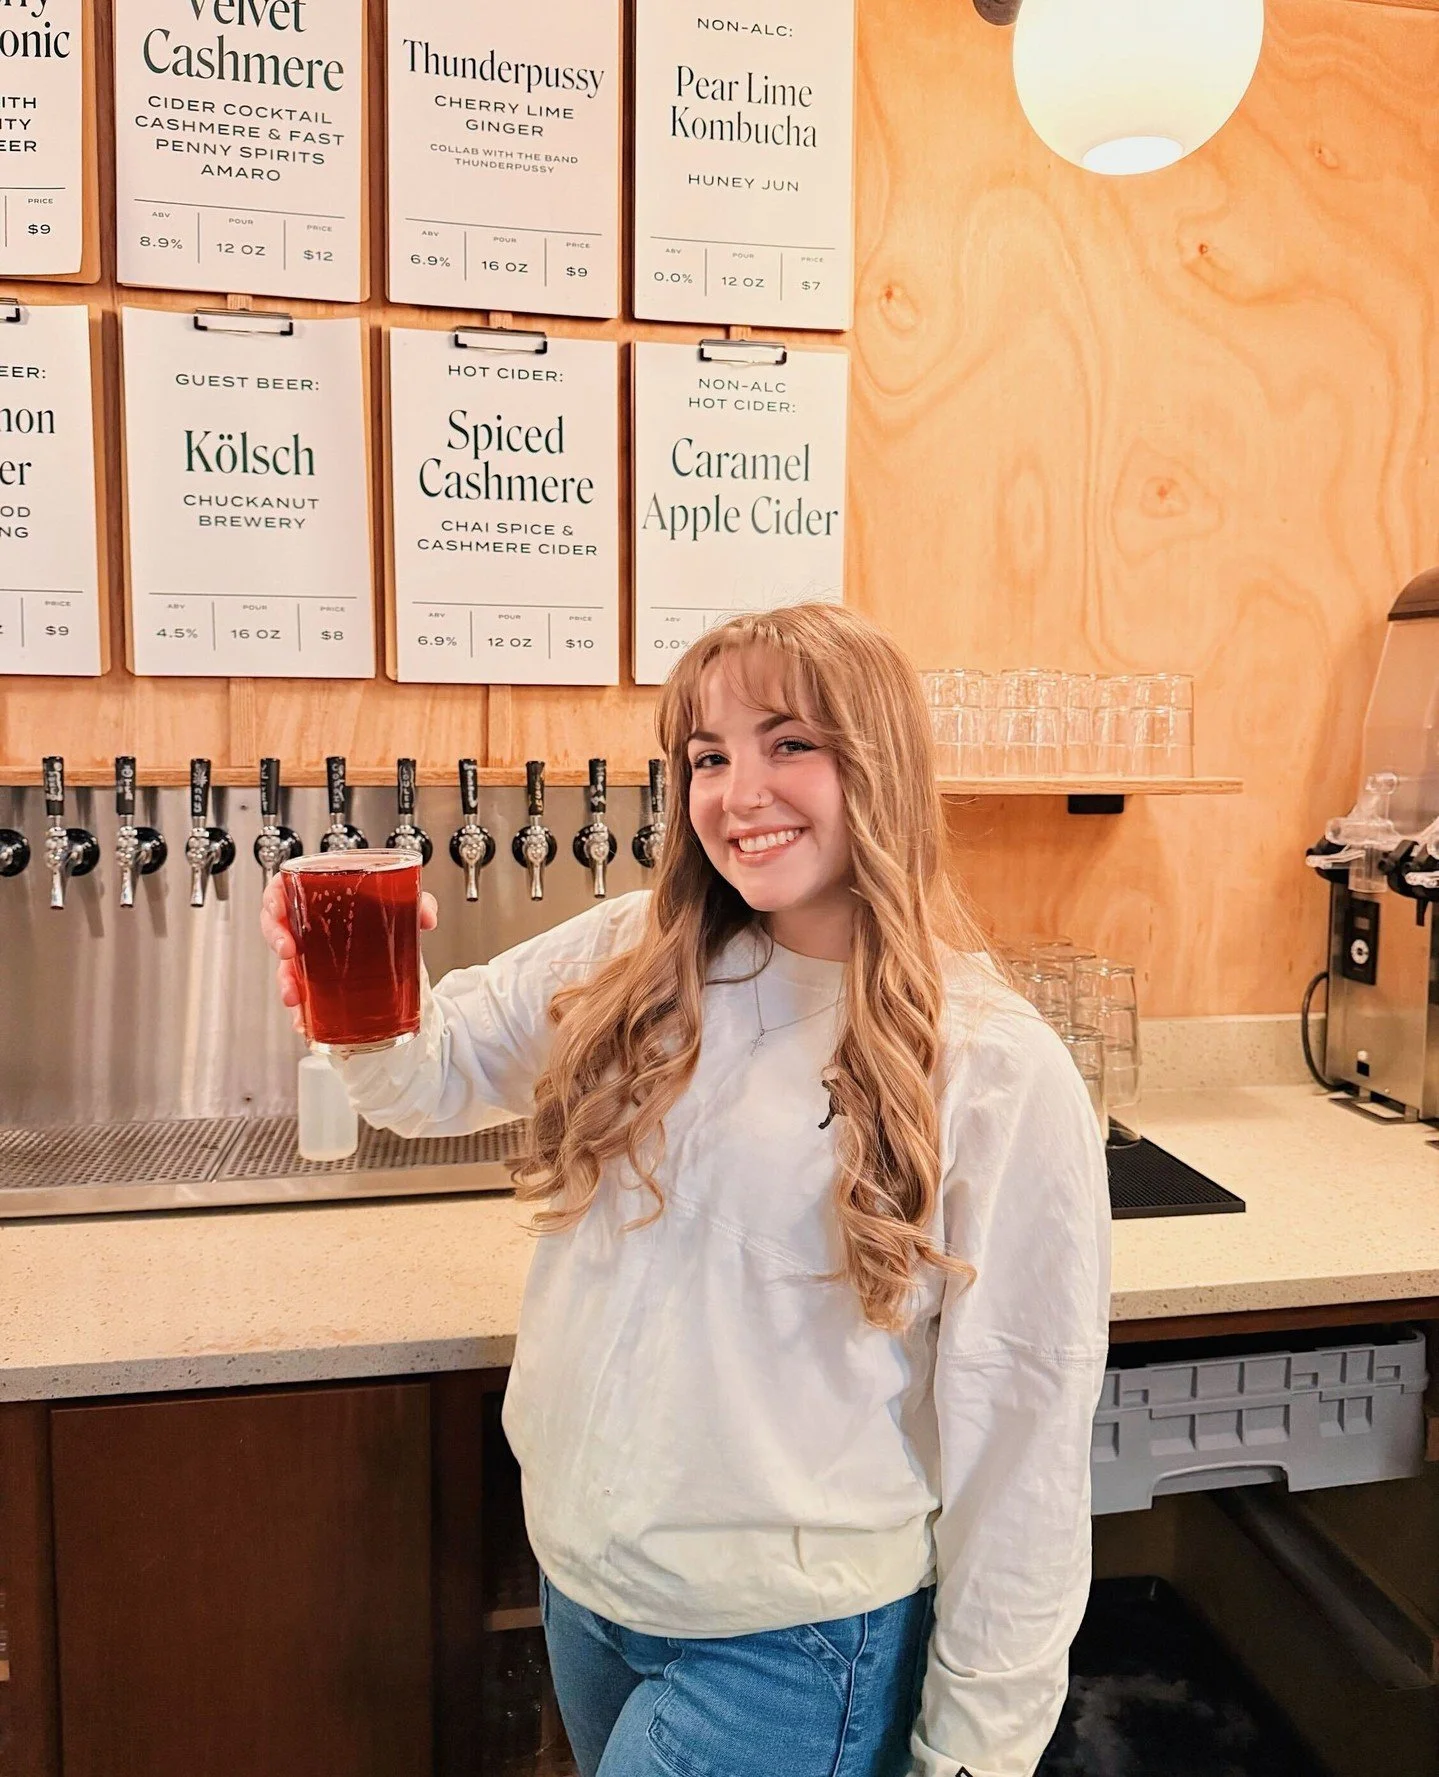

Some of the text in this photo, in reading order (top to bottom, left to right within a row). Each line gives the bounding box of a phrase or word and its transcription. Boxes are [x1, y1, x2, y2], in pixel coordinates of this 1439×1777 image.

[698, 18, 792, 37] NON-ALC:
[144, 28, 344, 91] Cashmere
[403, 39, 604, 98] Thunderpussy
[678, 66, 812, 107] Pear Lime
[148, 96, 332, 124] CIDER COCKTAIL
[435, 95, 573, 119] CHERRY LIME
[135, 115, 344, 145] CASHMERE & FAST
[466, 119, 543, 136] GINGER
[672, 105, 816, 147] Kombucha
[157, 139, 324, 164] PENNY SPIRITS
[430, 144, 578, 163] COLLAB WITH THE BAND
[201, 165, 280, 181] AMARO
[455, 157, 554, 173] THUNDERPUSSY
[689, 174, 798, 192] HUNEY JUN
[28, 224, 50, 235] $9
[140, 236, 182, 249] 8.9%
[217, 243, 265, 256] 12 OZ
[304, 250, 333, 261] $12
[411, 254, 450, 267] 6.9%
[482, 261, 528, 273] 16 OZ
[567, 267, 587, 277] $9
[654, 272, 692, 283] 0.0%
[722, 277, 764, 287] 12 OZ
[802, 281, 820, 290] $7
[449, 365, 562, 382] HOT CIDER:
[176, 374, 318, 390] GUEST BEER:
[699, 379, 785, 393] NON-ALC
[689, 397, 795, 413] HOT CIDER:
[447, 410, 563, 459] Spiced
[185, 430, 314, 475] Kölsch
[672, 438, 809, 481] Caramel
[420, 457, 593, 504] Cashmere
[184, 495, 319, 509] CHUCKANUT
[199, 515, 305, 529] BREWERY
[643, 493, 838, 541] Apple Cider
[442, 520, 573, 536] CHAI SPICE &
[418, 539, 597, 556] CASHMERE CIDER
[46, 626, 69, 636] $9
[156, 628, 198, 638] 4.5%
[231, 629, 281, 639] 16 OZ
[321, 631, 343, 640] $8
[418, 636, 457, 646] 6.9%
[488, 638, 532, 647] 12 OZ
[566, 639, 594, 648] $10
